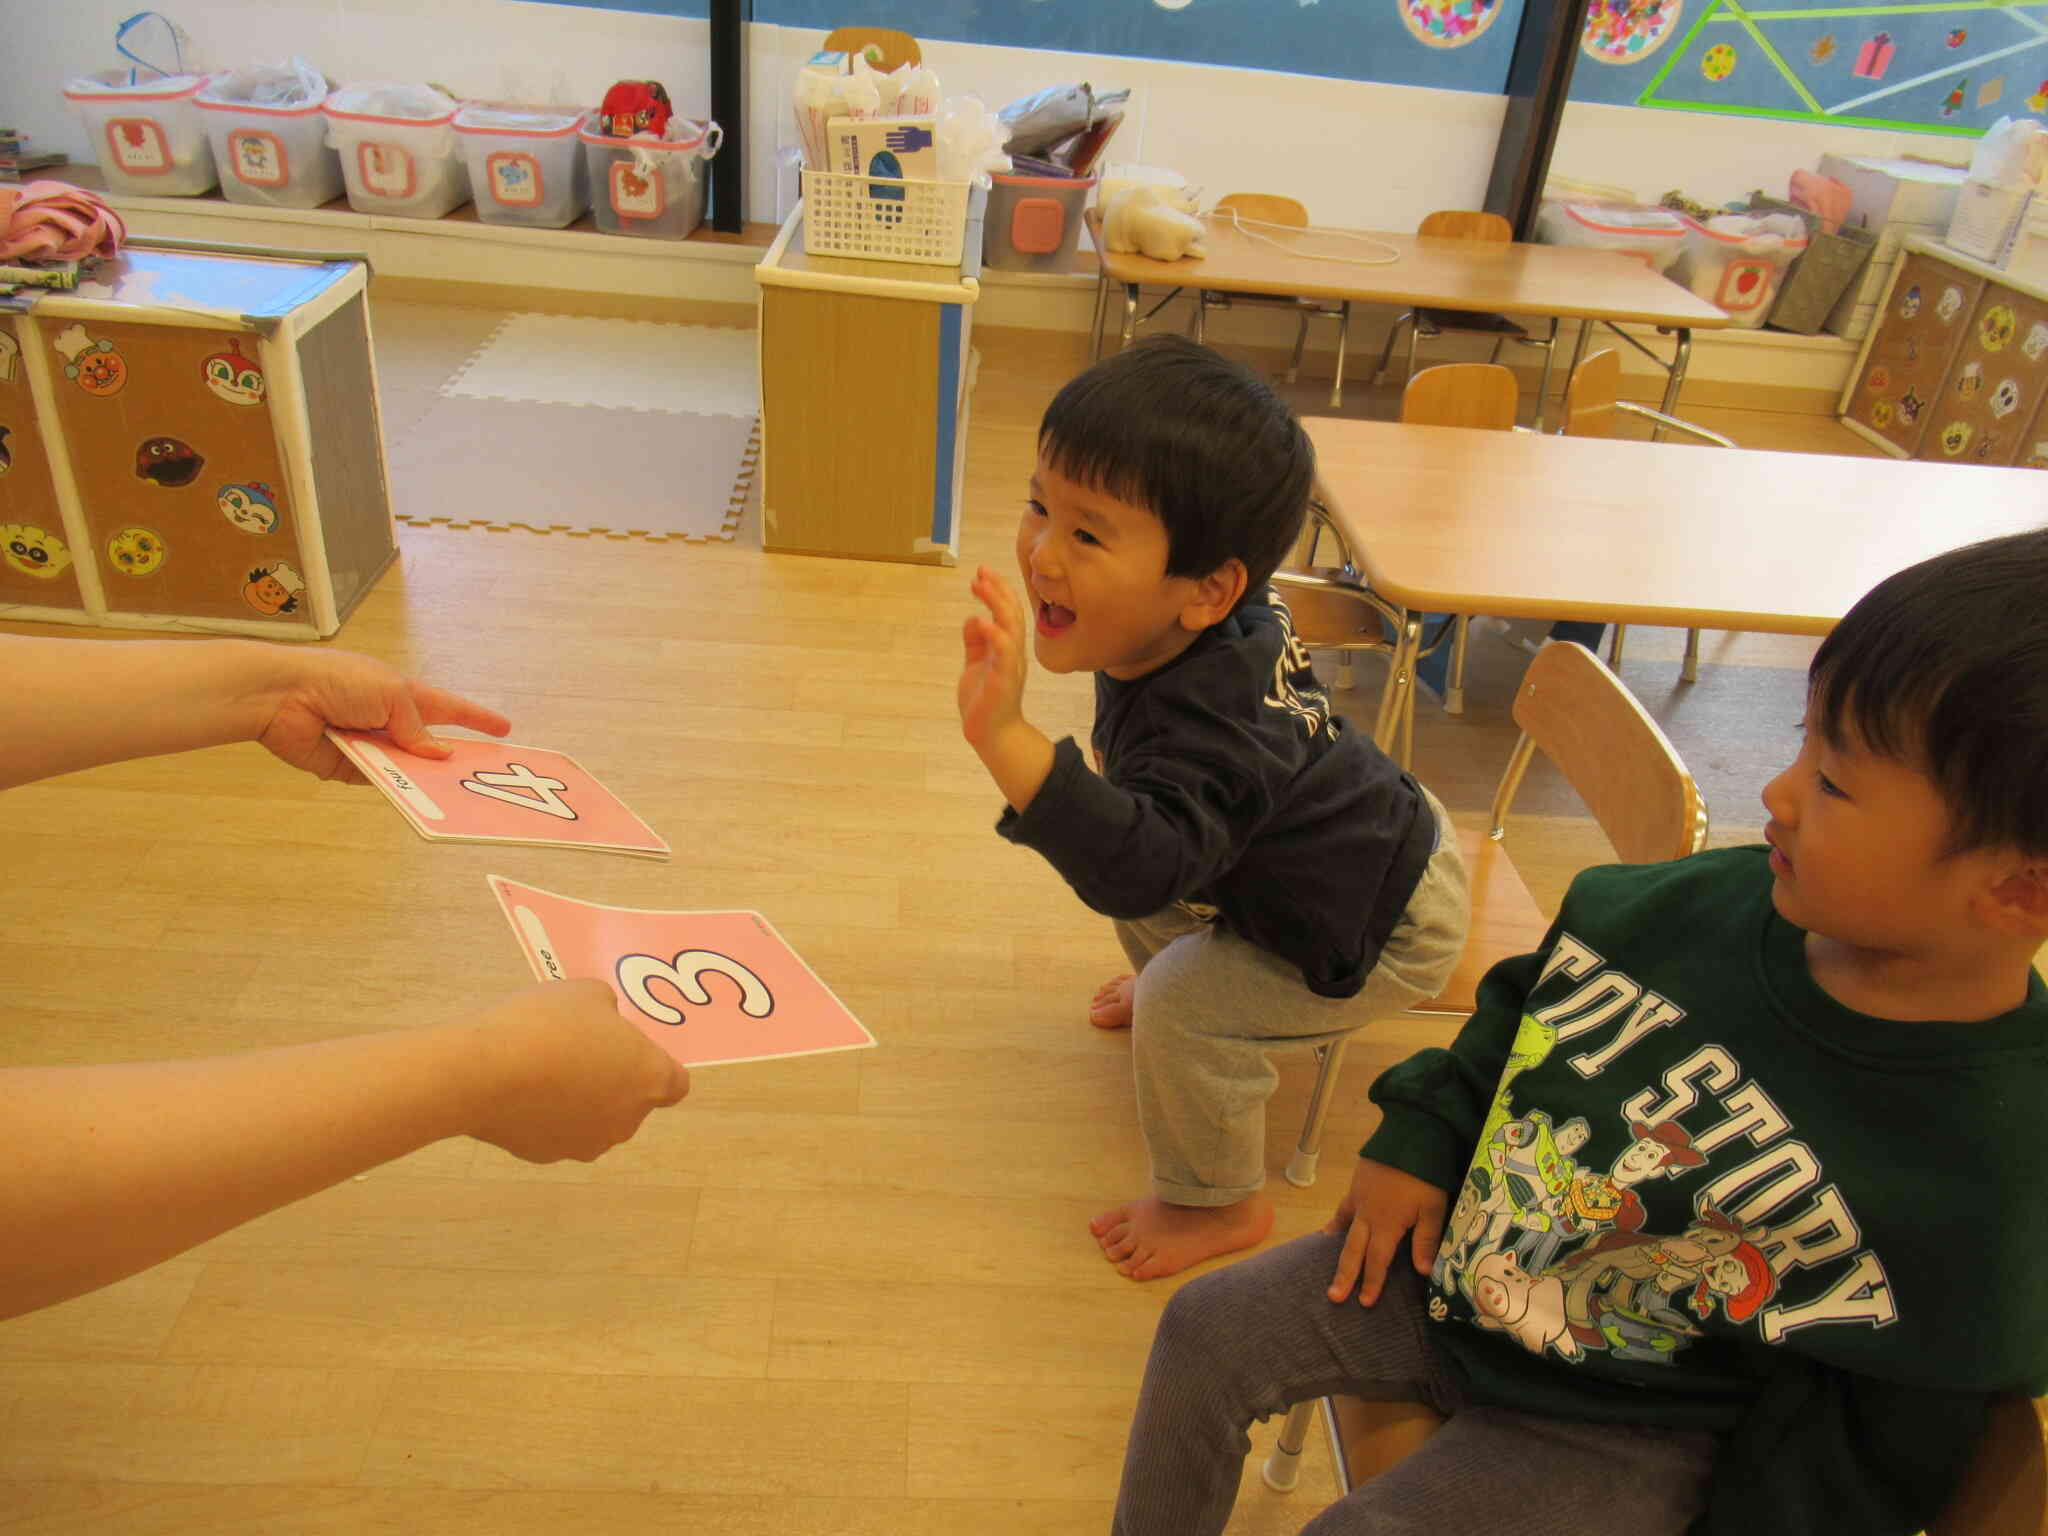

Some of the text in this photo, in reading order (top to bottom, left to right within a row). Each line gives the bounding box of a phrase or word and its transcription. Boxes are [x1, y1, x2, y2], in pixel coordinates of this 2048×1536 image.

[383, 766, 413, 791] four
[459, 763, 579, 820] 4
[540, 948, 561, 980] ree
[615, 948, 775, 1026] 3
[1528, 931, 1898, 1344] TOY STORY
